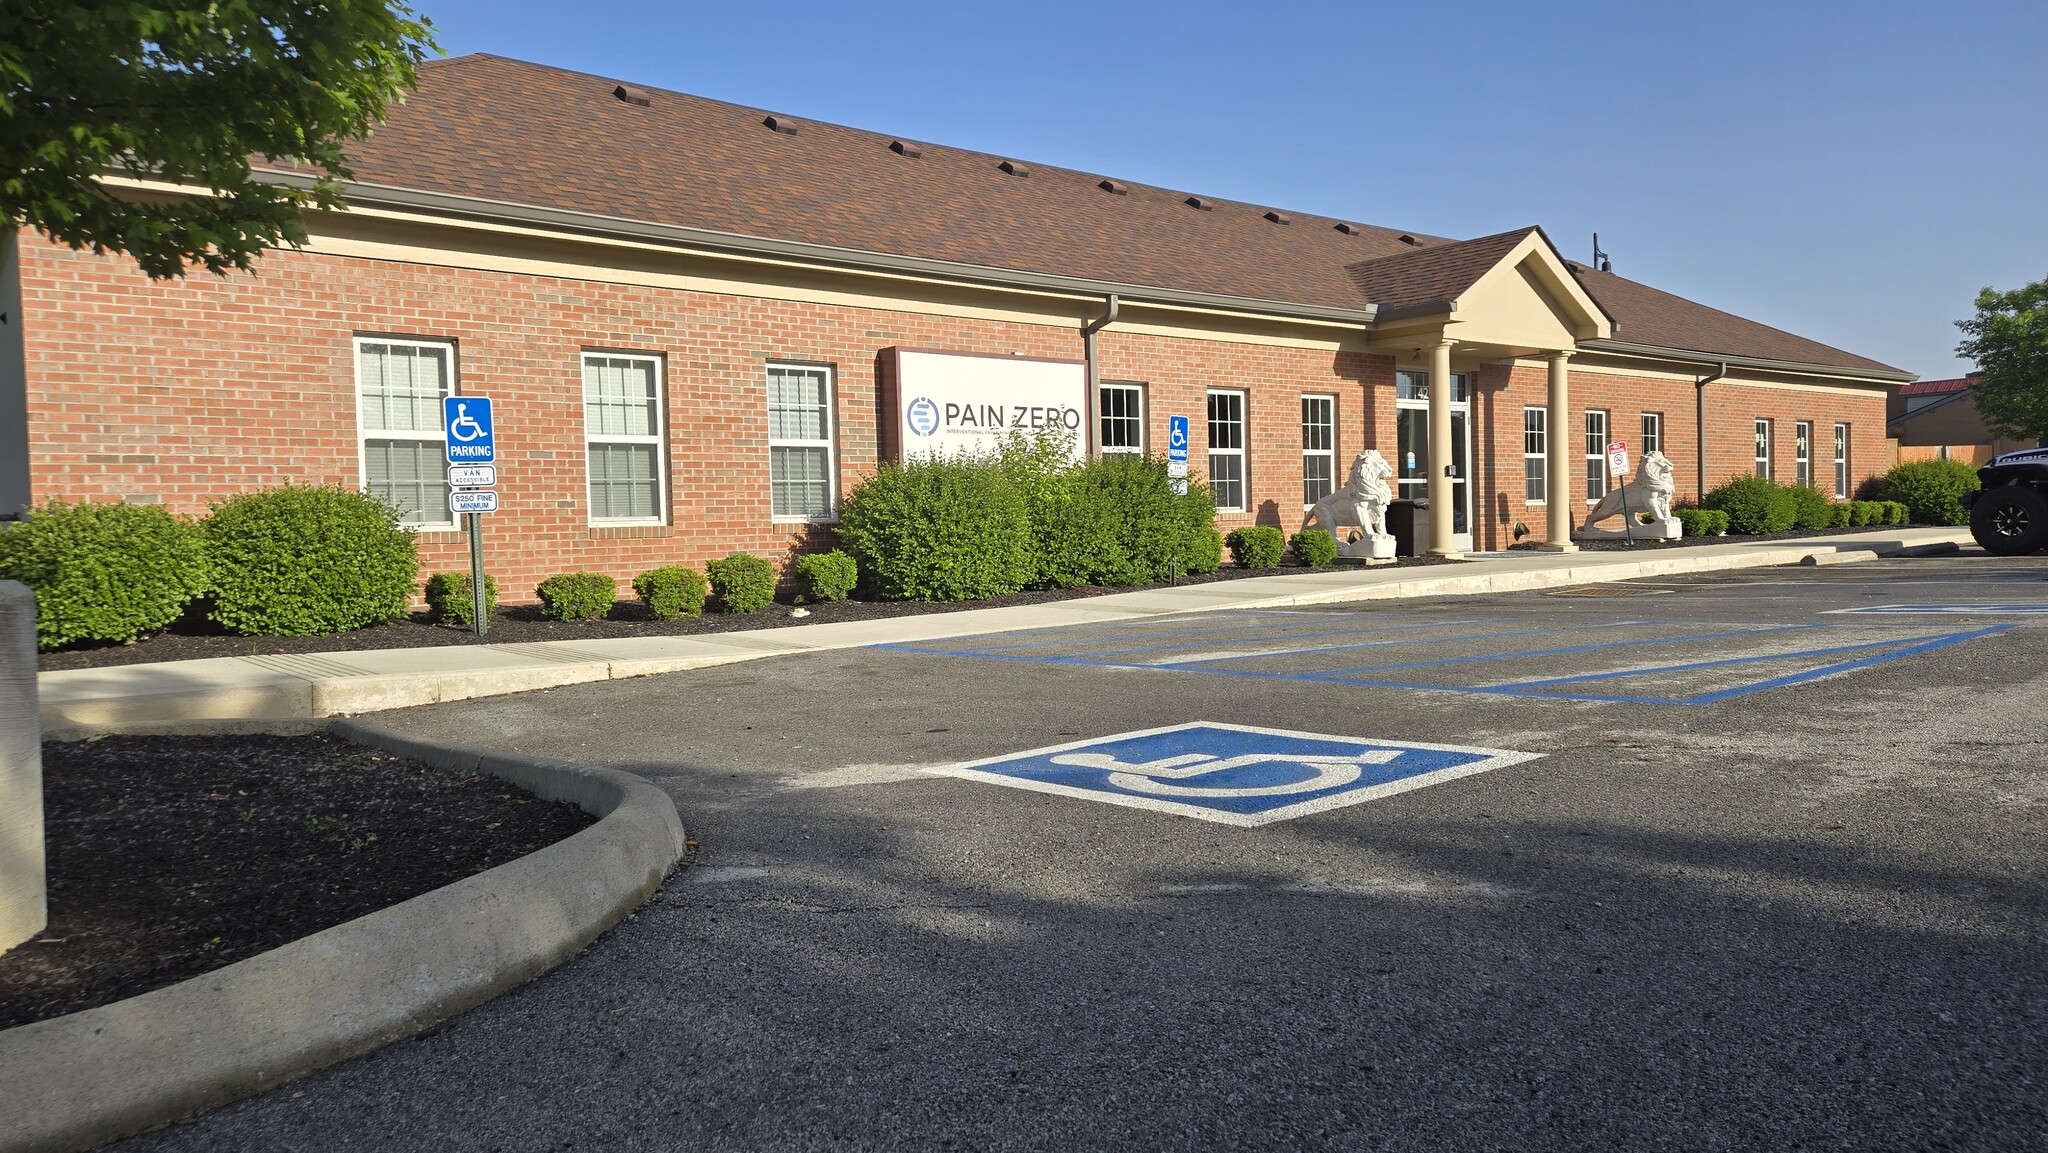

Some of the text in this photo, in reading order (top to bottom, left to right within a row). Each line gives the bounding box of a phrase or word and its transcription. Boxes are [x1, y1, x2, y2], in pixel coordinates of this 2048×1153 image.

[945, 403, 1080, 429] PAIN ZERO
[450, 446, 491, 456] PARKING
[1170, 449, 1187, 457] PARKING
